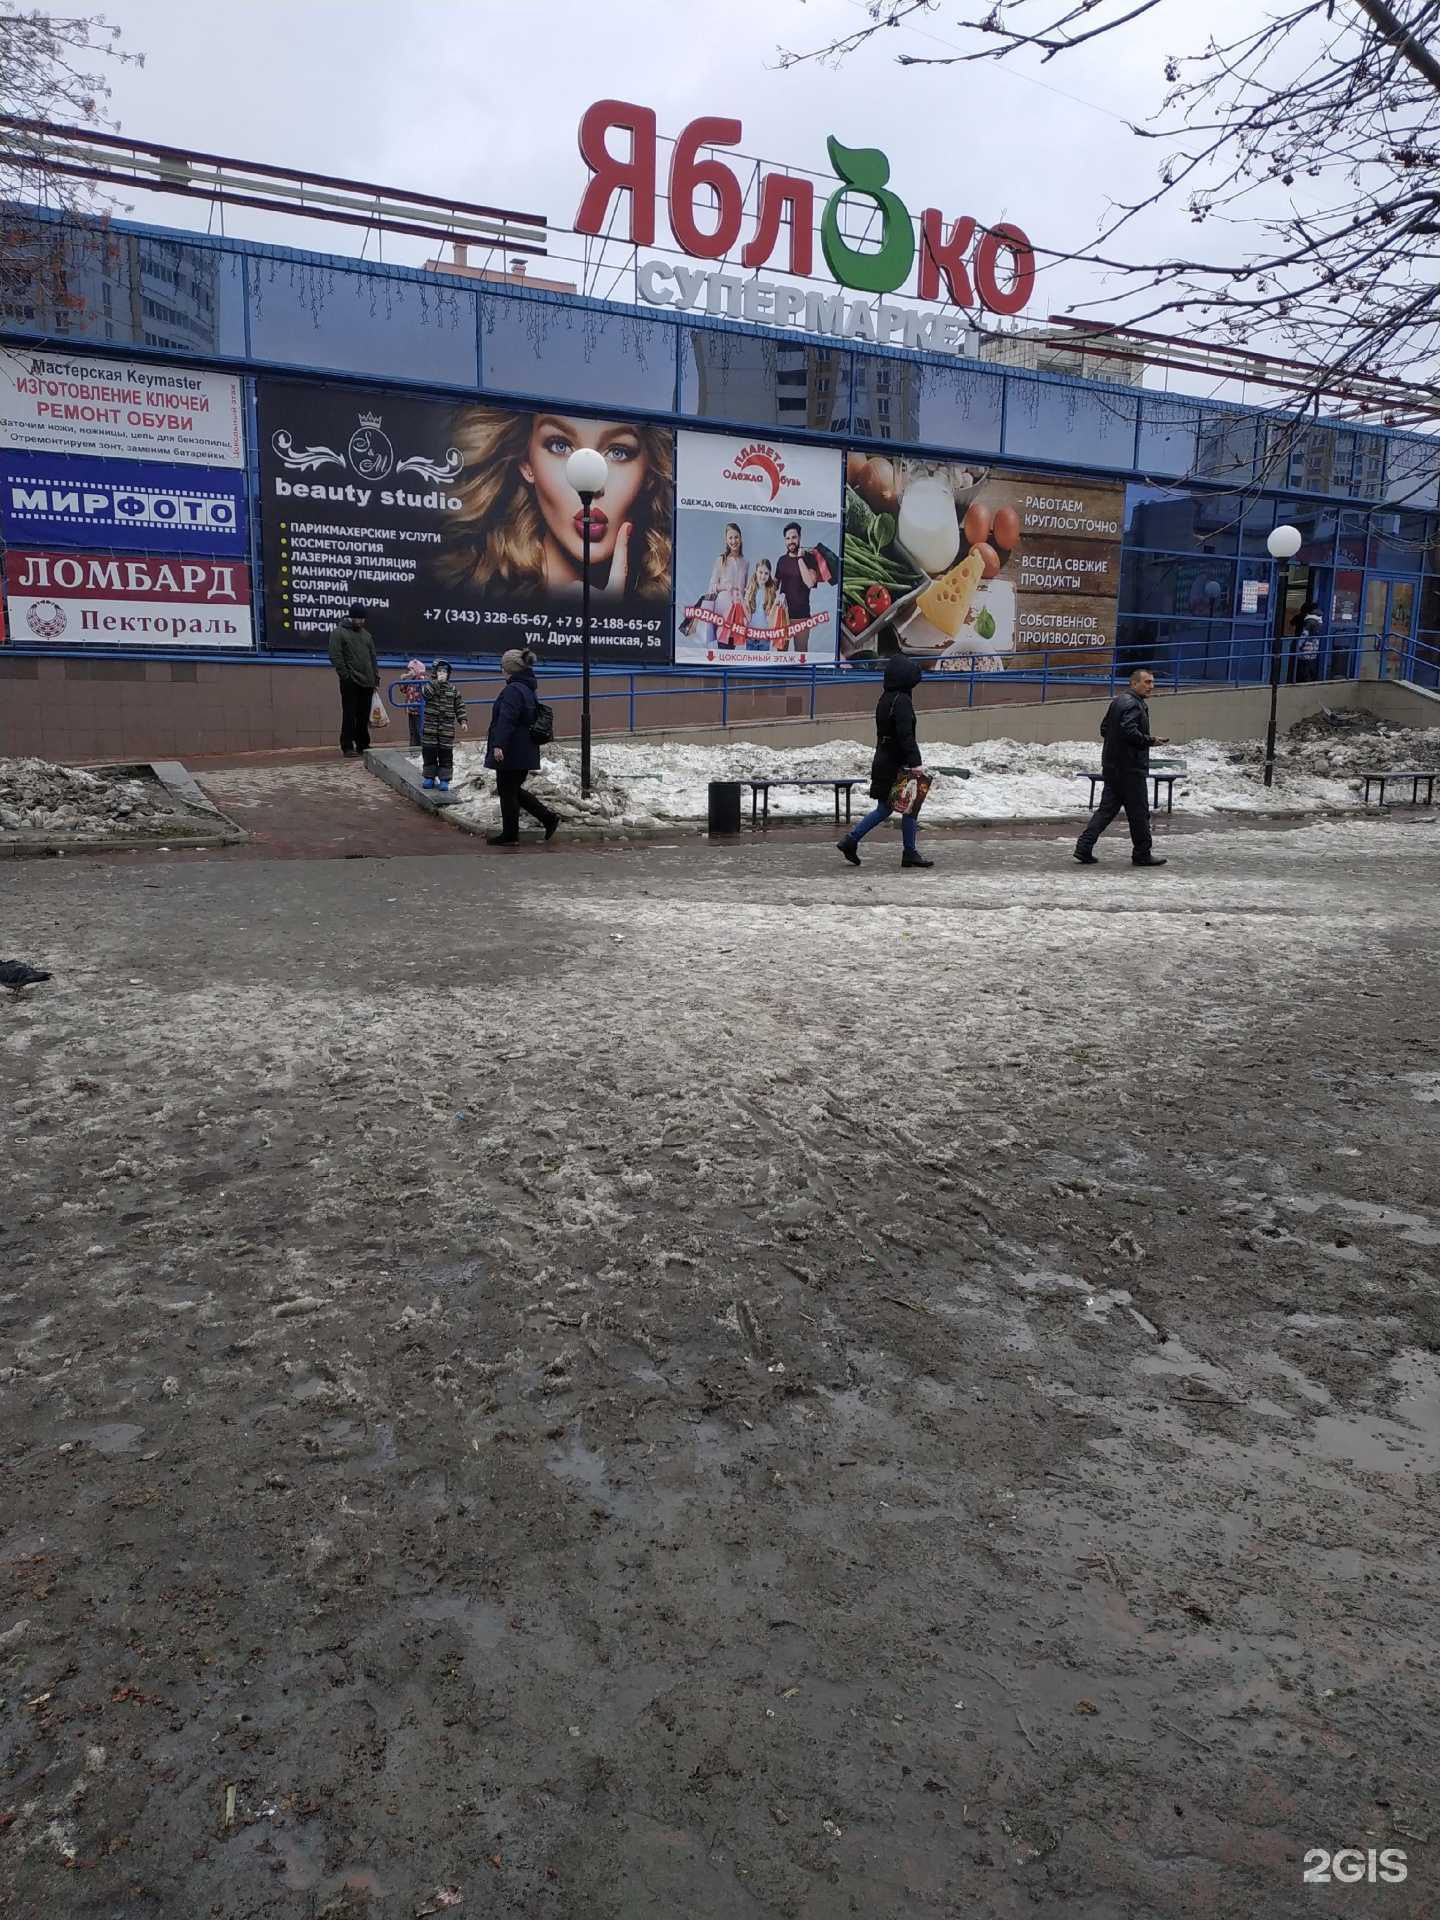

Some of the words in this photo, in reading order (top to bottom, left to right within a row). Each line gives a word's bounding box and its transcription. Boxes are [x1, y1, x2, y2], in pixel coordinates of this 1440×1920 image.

[574, 99, 1036, 315] Яблоко
[637, 260, 987, 358] СУПЕРМАРКЕТ
[32, 359, 122, 382] Мастерская
[127, 369, 202, 391] Keymaster
[16, 377, 142, 405] ИЗГОТОВЛЕНИЕ
[146, 391, 209, 412] КЛЮЧЕЙ
[37, 401, 121, 424] РЕМОНТ
[127, 411, 193, 431] ОБУВИ
[10, 433, 96, 448] Отремонтируем
[734, 443, 786, 473] ПЛАНЕТА
[275, 477, 372, 507] beauty
[380, 489, 463, 511] studio
[1025, 496, 1083, 513] РАБОТАЕМ
[290, 522, 397, 540] ПАРИКМАХЕРСКИЕ
[399, 530, 442, 544] УСЛУГИ
[1024, 514, 1118, 534] КРУГЛОСУТОЧНО
[290, 537, 384, 553] КОСМЕТОЛОГИЯ
[290, 551, 351, 565] ЛАЗЕРНАЯ
[354, 555, 417, 570] ЭПИЛЯЦИЯ
[1021, 556, 1063, 570] ВСЕГДА
[1064, 559, 1108, 573] СВЕЖИЕ
[19, 557, 237, 600] ЛОМБАРД
[291, 565, 416, 583] МАНИКЮР/ПЕДИКЮР
[1020, 573, 1081, 589] ПРОДУКТЫ
[292, 578, 349, 592] СОЛЯРИЙ
[81, 609, 237, 637] Пектораль
[423, 608, 441, 622] +7
[445, 609, 481, 625] (343)
[484, 613, 552, 628] 328-65-67,
[556, 616, 573, 628] +7
[575, 616, 661, 632] 92-188-65-67
[685, 607, 725, 626] МОДНО
[731, 623, 746, 636] НЕ
[746, 628, 785, 640] ЗНАЧИТ
[787, 612, 831, 636] ДОРОГО!
[1019, 614, 1098, 629] СОБСТВЕННОЕ
[525, 632, 545, 645] ул.
[547, 632, 644, 648] Дружнинская,
[647, 635, 661, 647] 5а
[1018, 631, 1106, 647] ПРОИЗВОДСТВО
[719, 652, 772, 663] ЦОКОЛЬНЫЙ
[773, 655, 797, 663] ЭТАЖ
